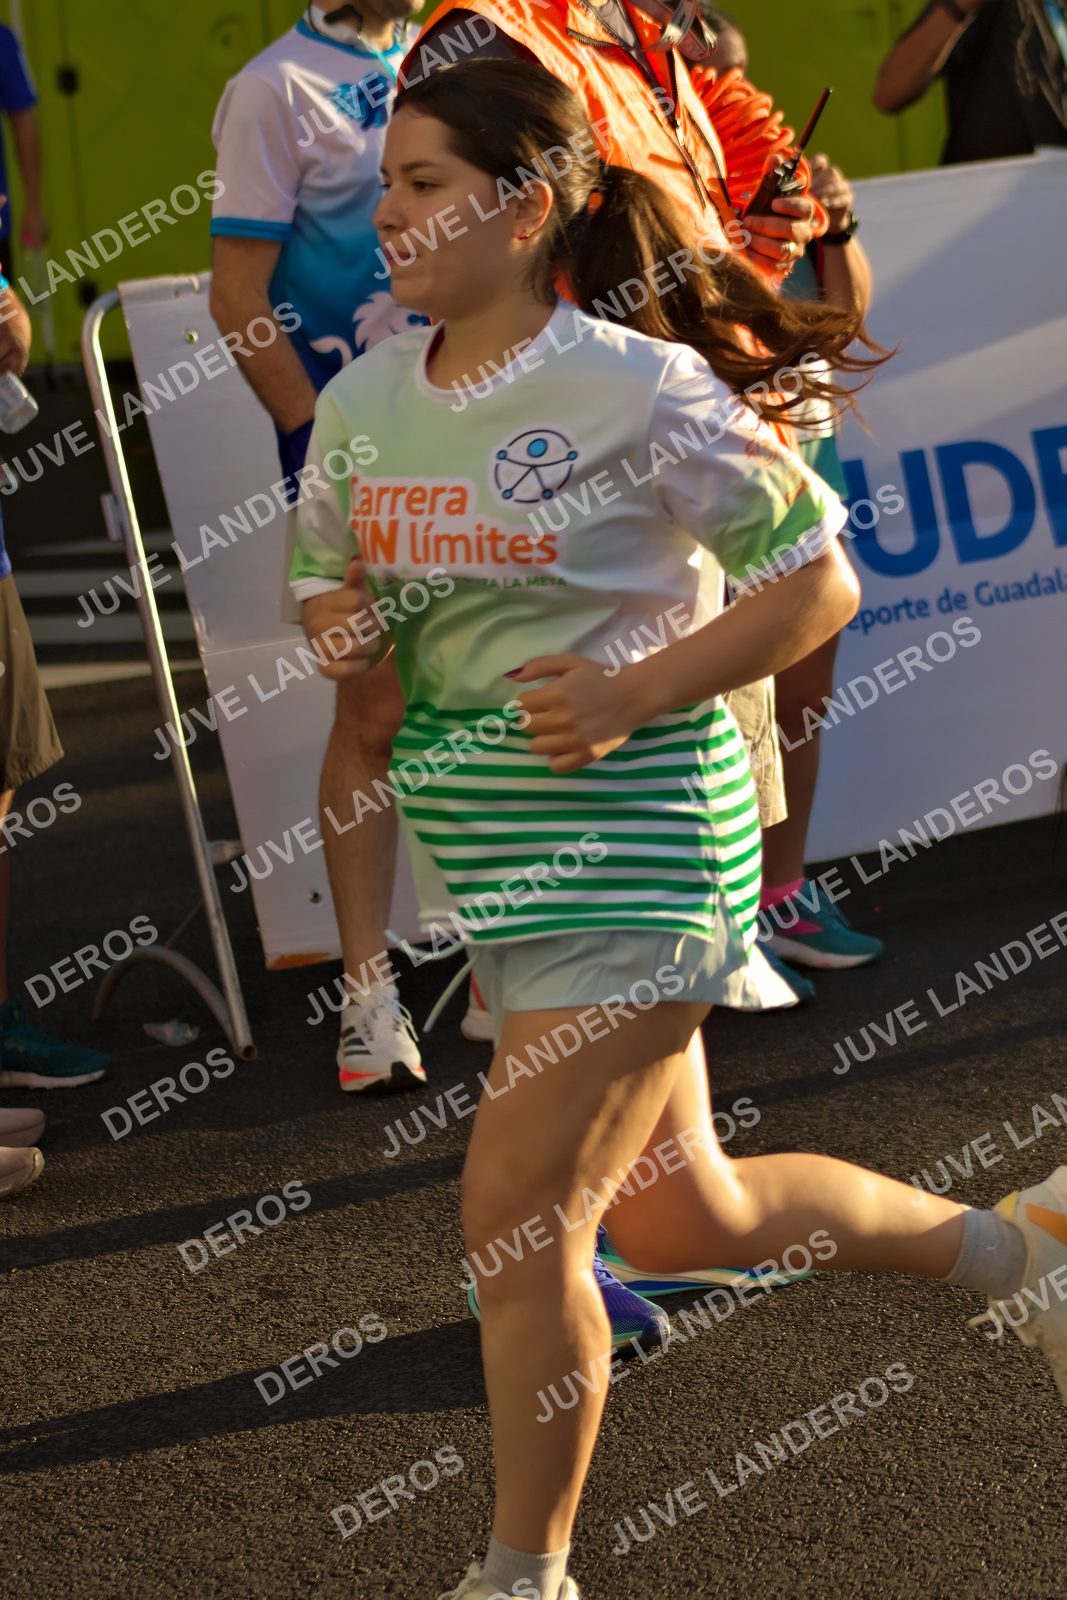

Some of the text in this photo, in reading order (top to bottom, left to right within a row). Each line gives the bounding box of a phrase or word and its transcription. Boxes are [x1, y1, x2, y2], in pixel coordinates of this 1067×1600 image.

[409, 521, 559, 565] límites
[937, 588, 968, 614] de
[974, 568, 1067, 607] Guadal
